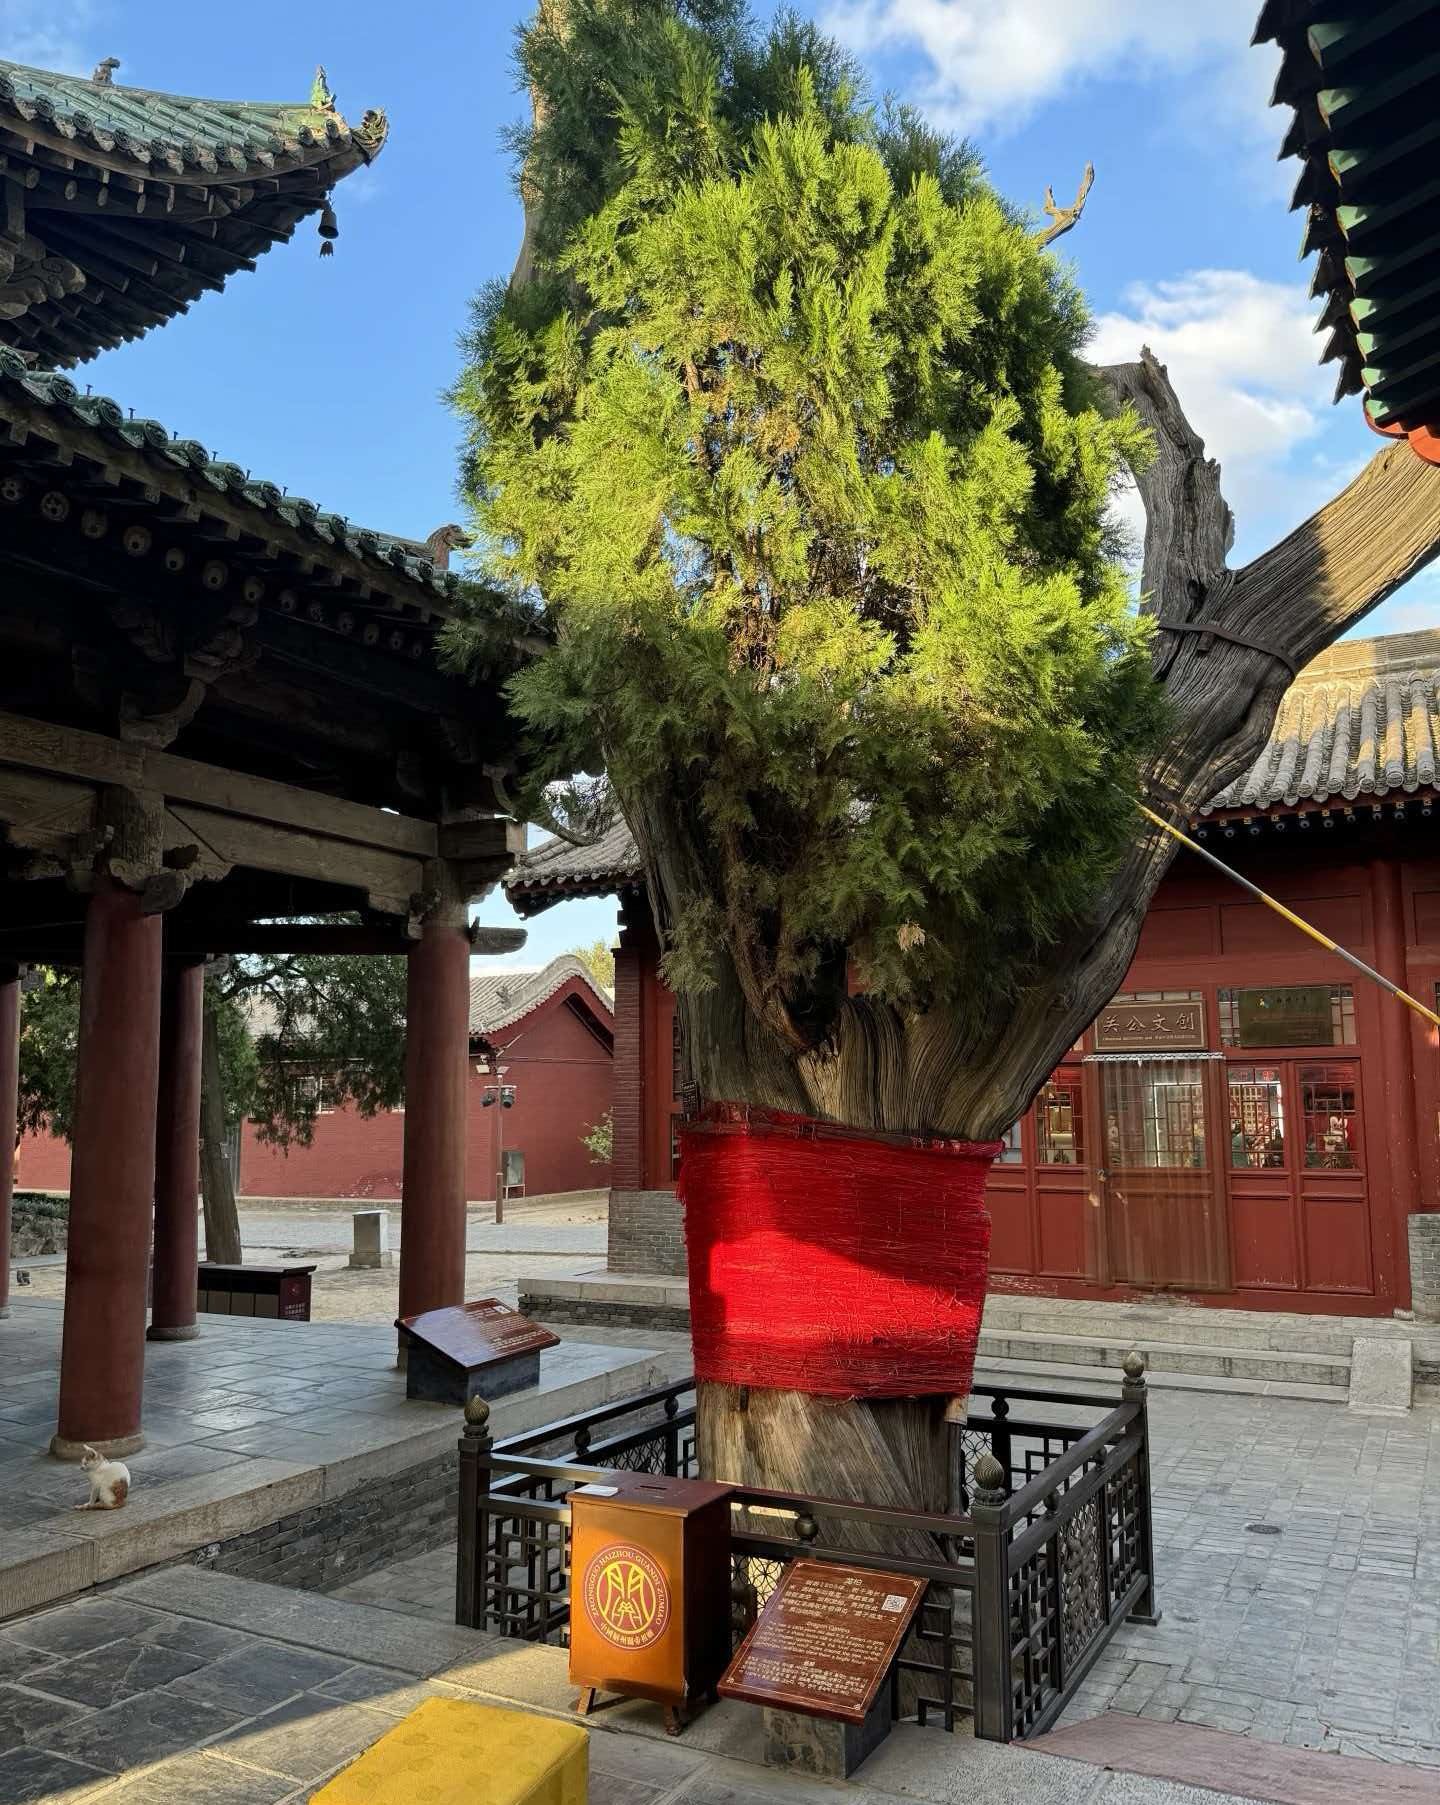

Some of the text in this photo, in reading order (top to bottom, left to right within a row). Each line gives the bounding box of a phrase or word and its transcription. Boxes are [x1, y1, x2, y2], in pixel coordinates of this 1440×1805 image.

[1103, 1012, 1194, 1032] 关公文创
[599, 1551, 635, 1566] HAIZHOU
